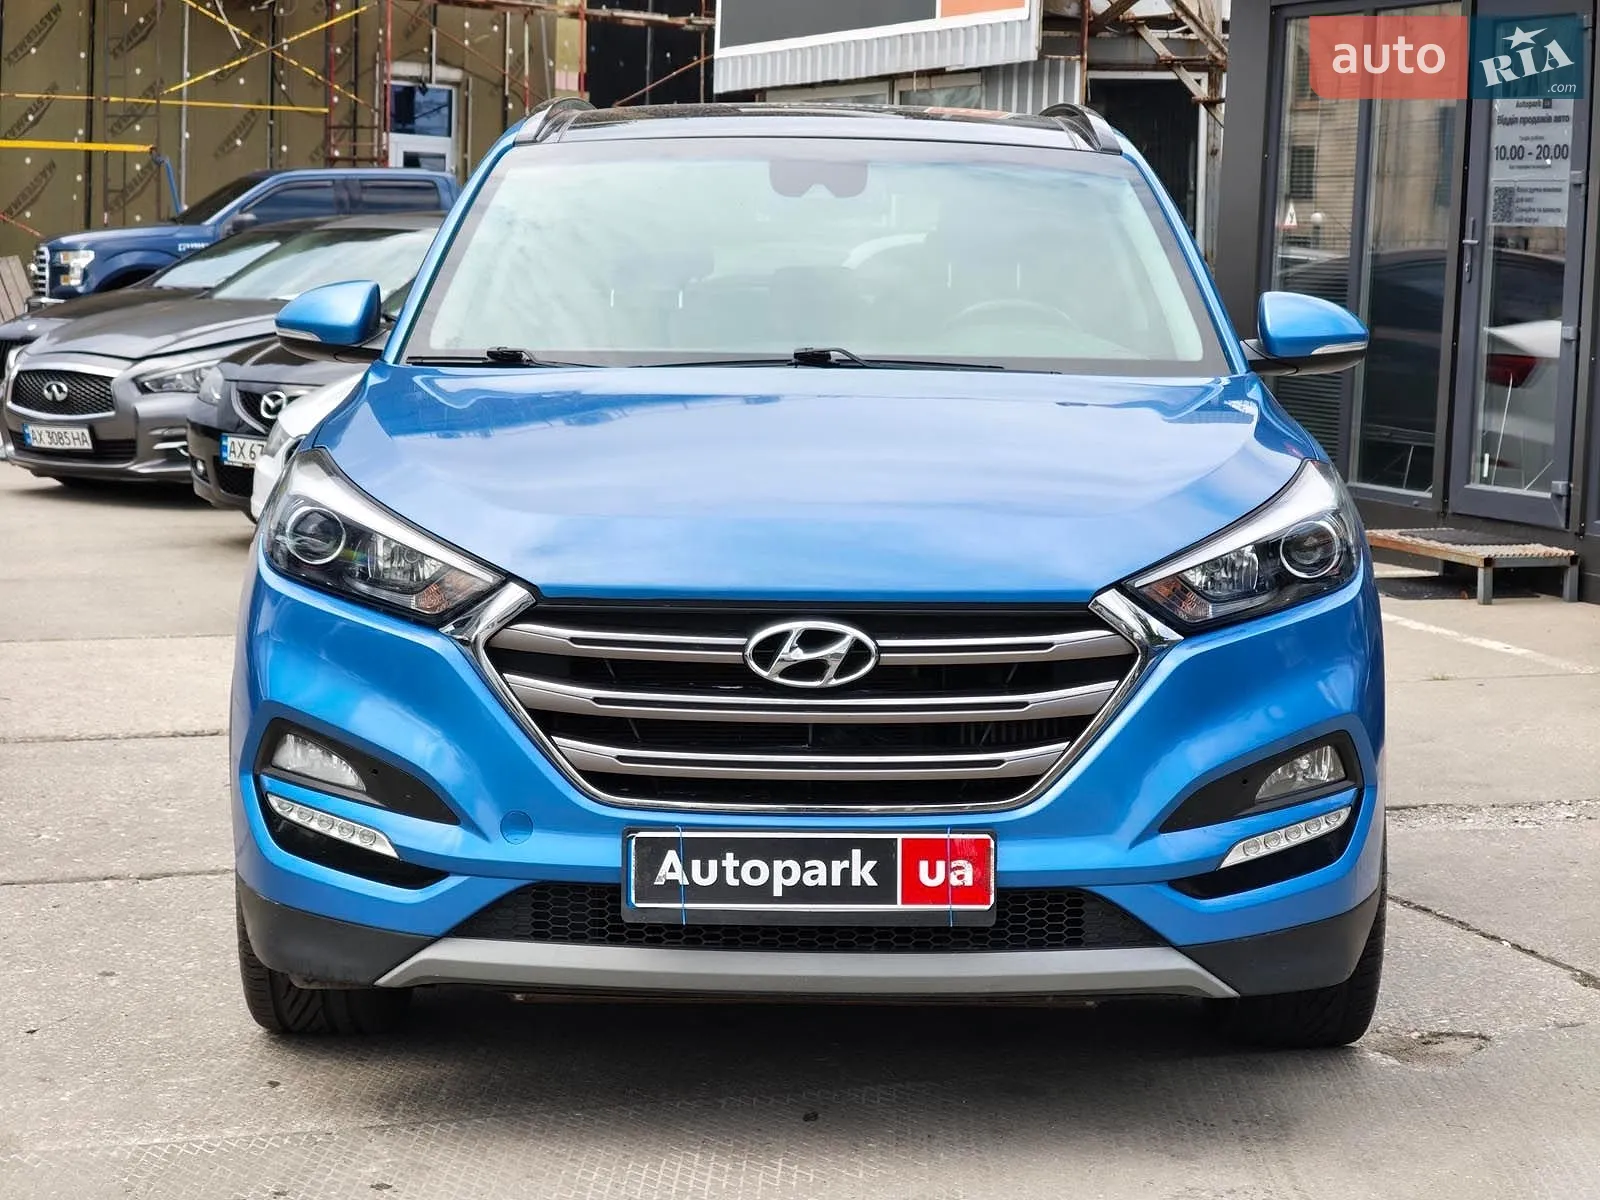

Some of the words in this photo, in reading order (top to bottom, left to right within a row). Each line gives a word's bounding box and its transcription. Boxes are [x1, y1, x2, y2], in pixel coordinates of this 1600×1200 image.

[4, 3, 62, 67] MASTERMAX
[1495, 145, 1525, 160] 10.00
[1536, 144, 1569, 160] 20.00
[31, 429, 45, 445] AX
[229, 441, 246, 459] AX
[653, 849, 878, 896] Autopark
[918, 859, 974, 887] ua
